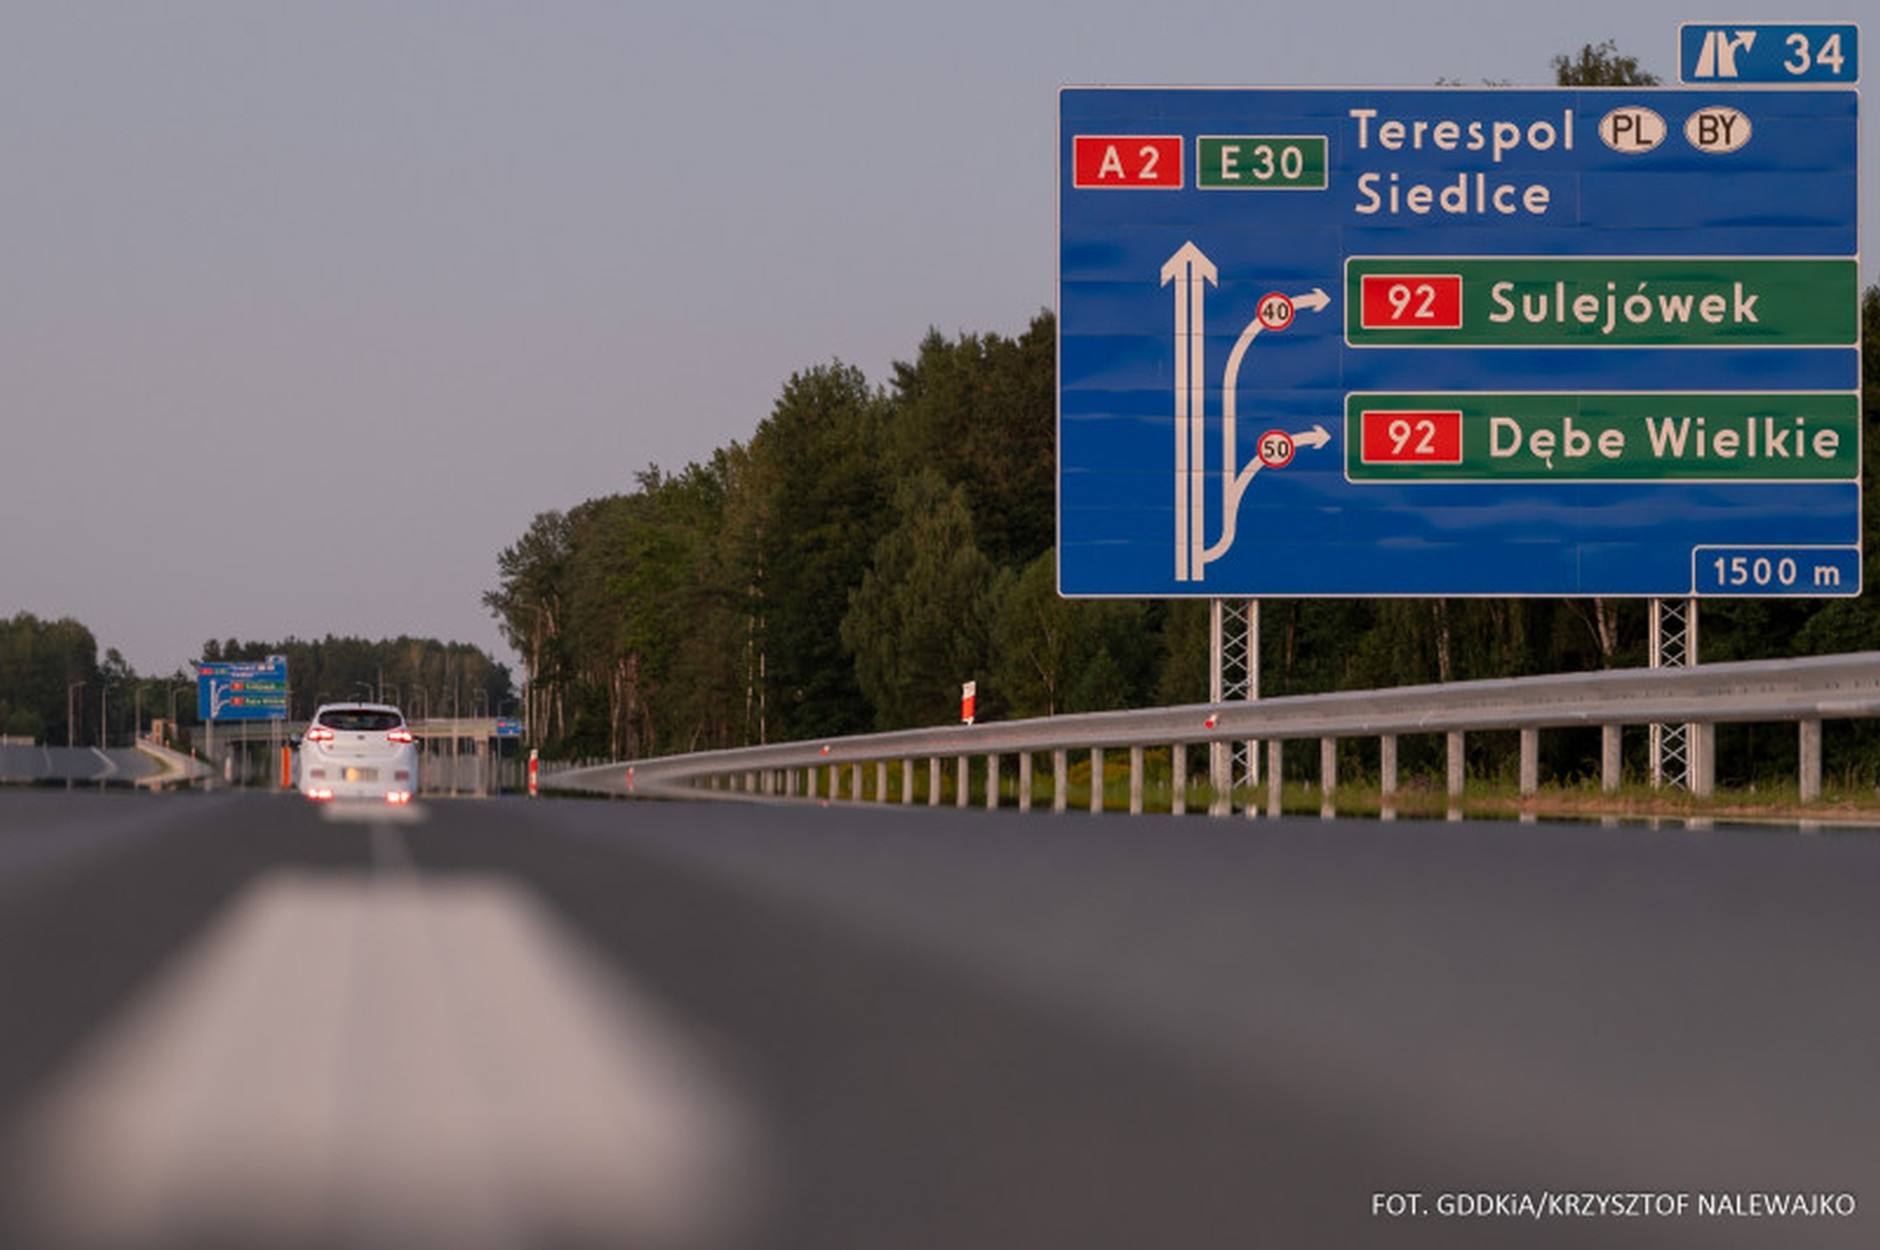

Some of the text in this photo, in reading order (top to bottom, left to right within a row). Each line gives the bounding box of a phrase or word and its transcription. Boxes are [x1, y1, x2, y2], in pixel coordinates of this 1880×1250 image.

[1784, 34, 1845, 74] 34
[1349, 108, 1573, 161] Terespol
[1612, 115, 1654, 146] PL
[1698, 115, 1738, 146] BY
[1098, 146, 1159, 179] A 2
[1221, 146, 1303, 179] E 30
[1355, 173, 1551, 214] Siedlce
[1262, 301, 1289, 321] 40
[1388, 284, 1436, 320] 92
[1489, 282, 1759, 335] Sulejówek
[1262, 439, 1290, 460] 50
[1388, 420, 1436, 455] 92
[1490, 416, 1841, 468] Dębe Wielkie
[1713, 557, 1841, 586] 1500 m
